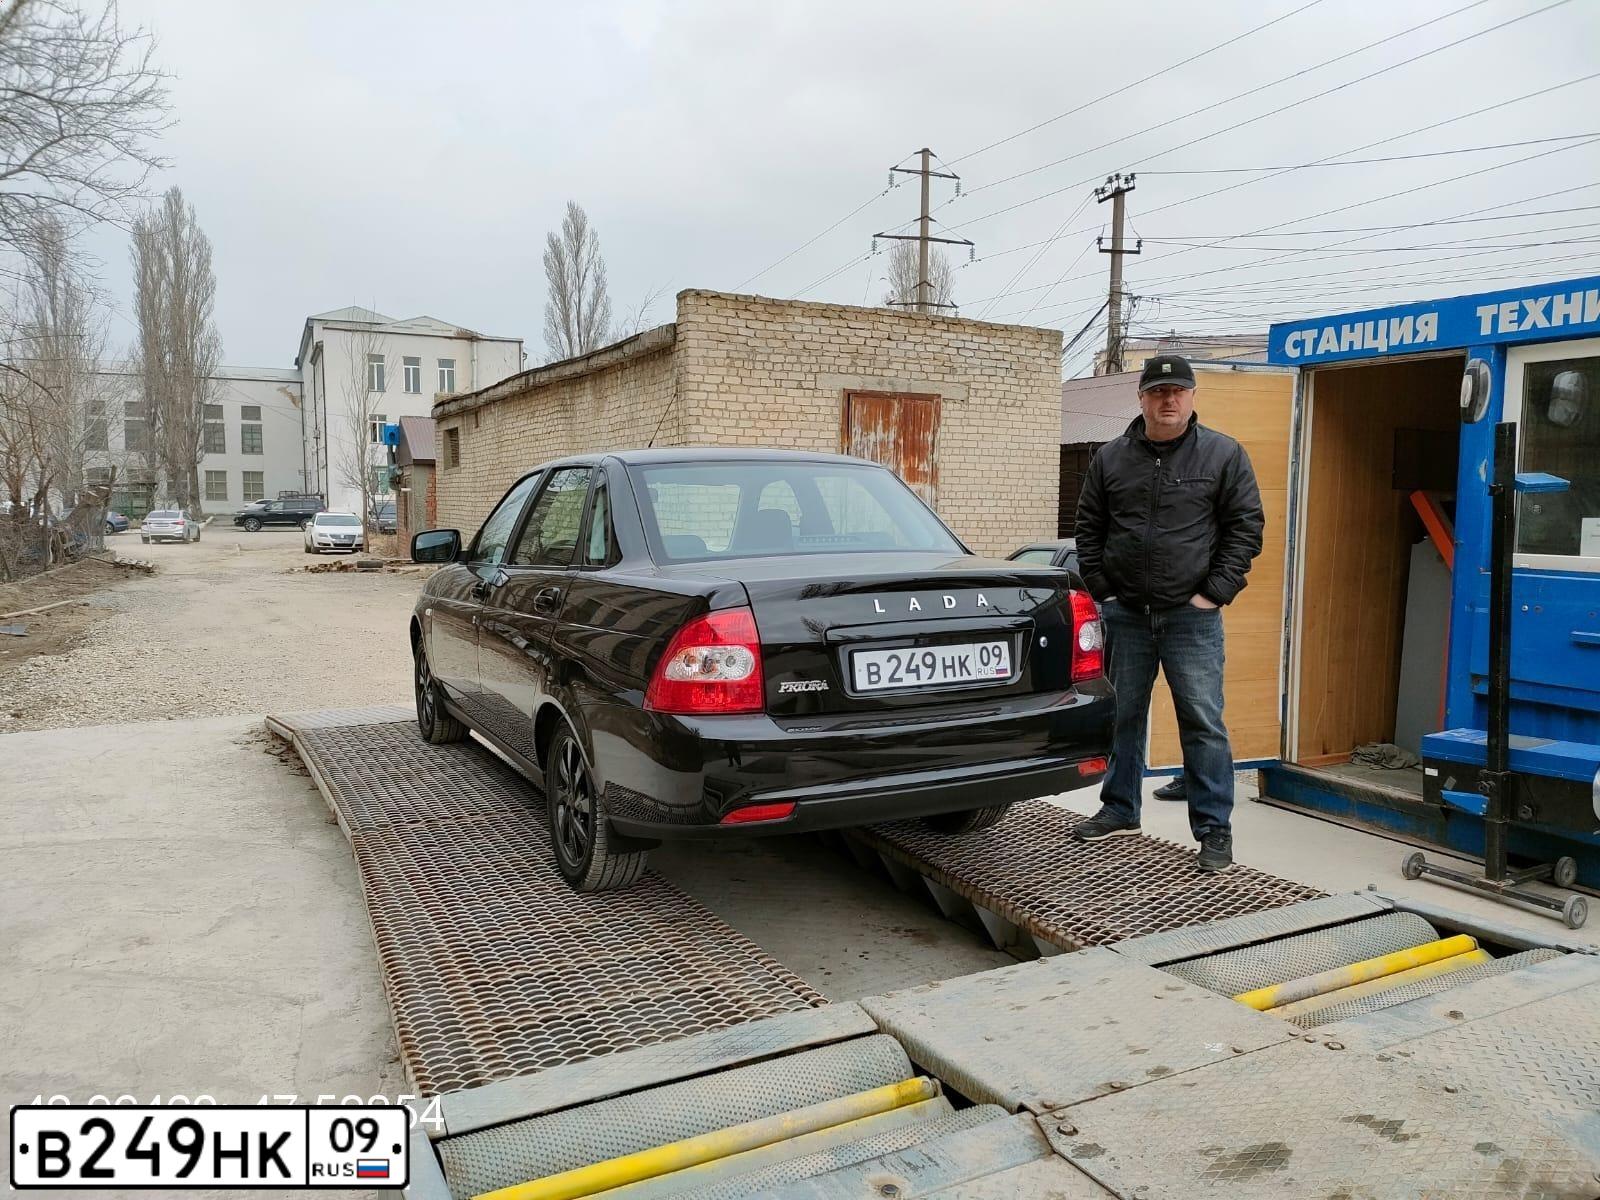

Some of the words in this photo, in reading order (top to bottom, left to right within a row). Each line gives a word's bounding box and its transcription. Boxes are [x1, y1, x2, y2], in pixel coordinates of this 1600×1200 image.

[1285, 312, 1439, 358] СТАНЦИЯ
[873, 593, 988, 614] LADA
[866, 651, 972, 685] В249НК
[979, 644, 1003, 667] 09
[977, 666, 995, 676] RUS
[778, 679, 830, 693] PRIORA
